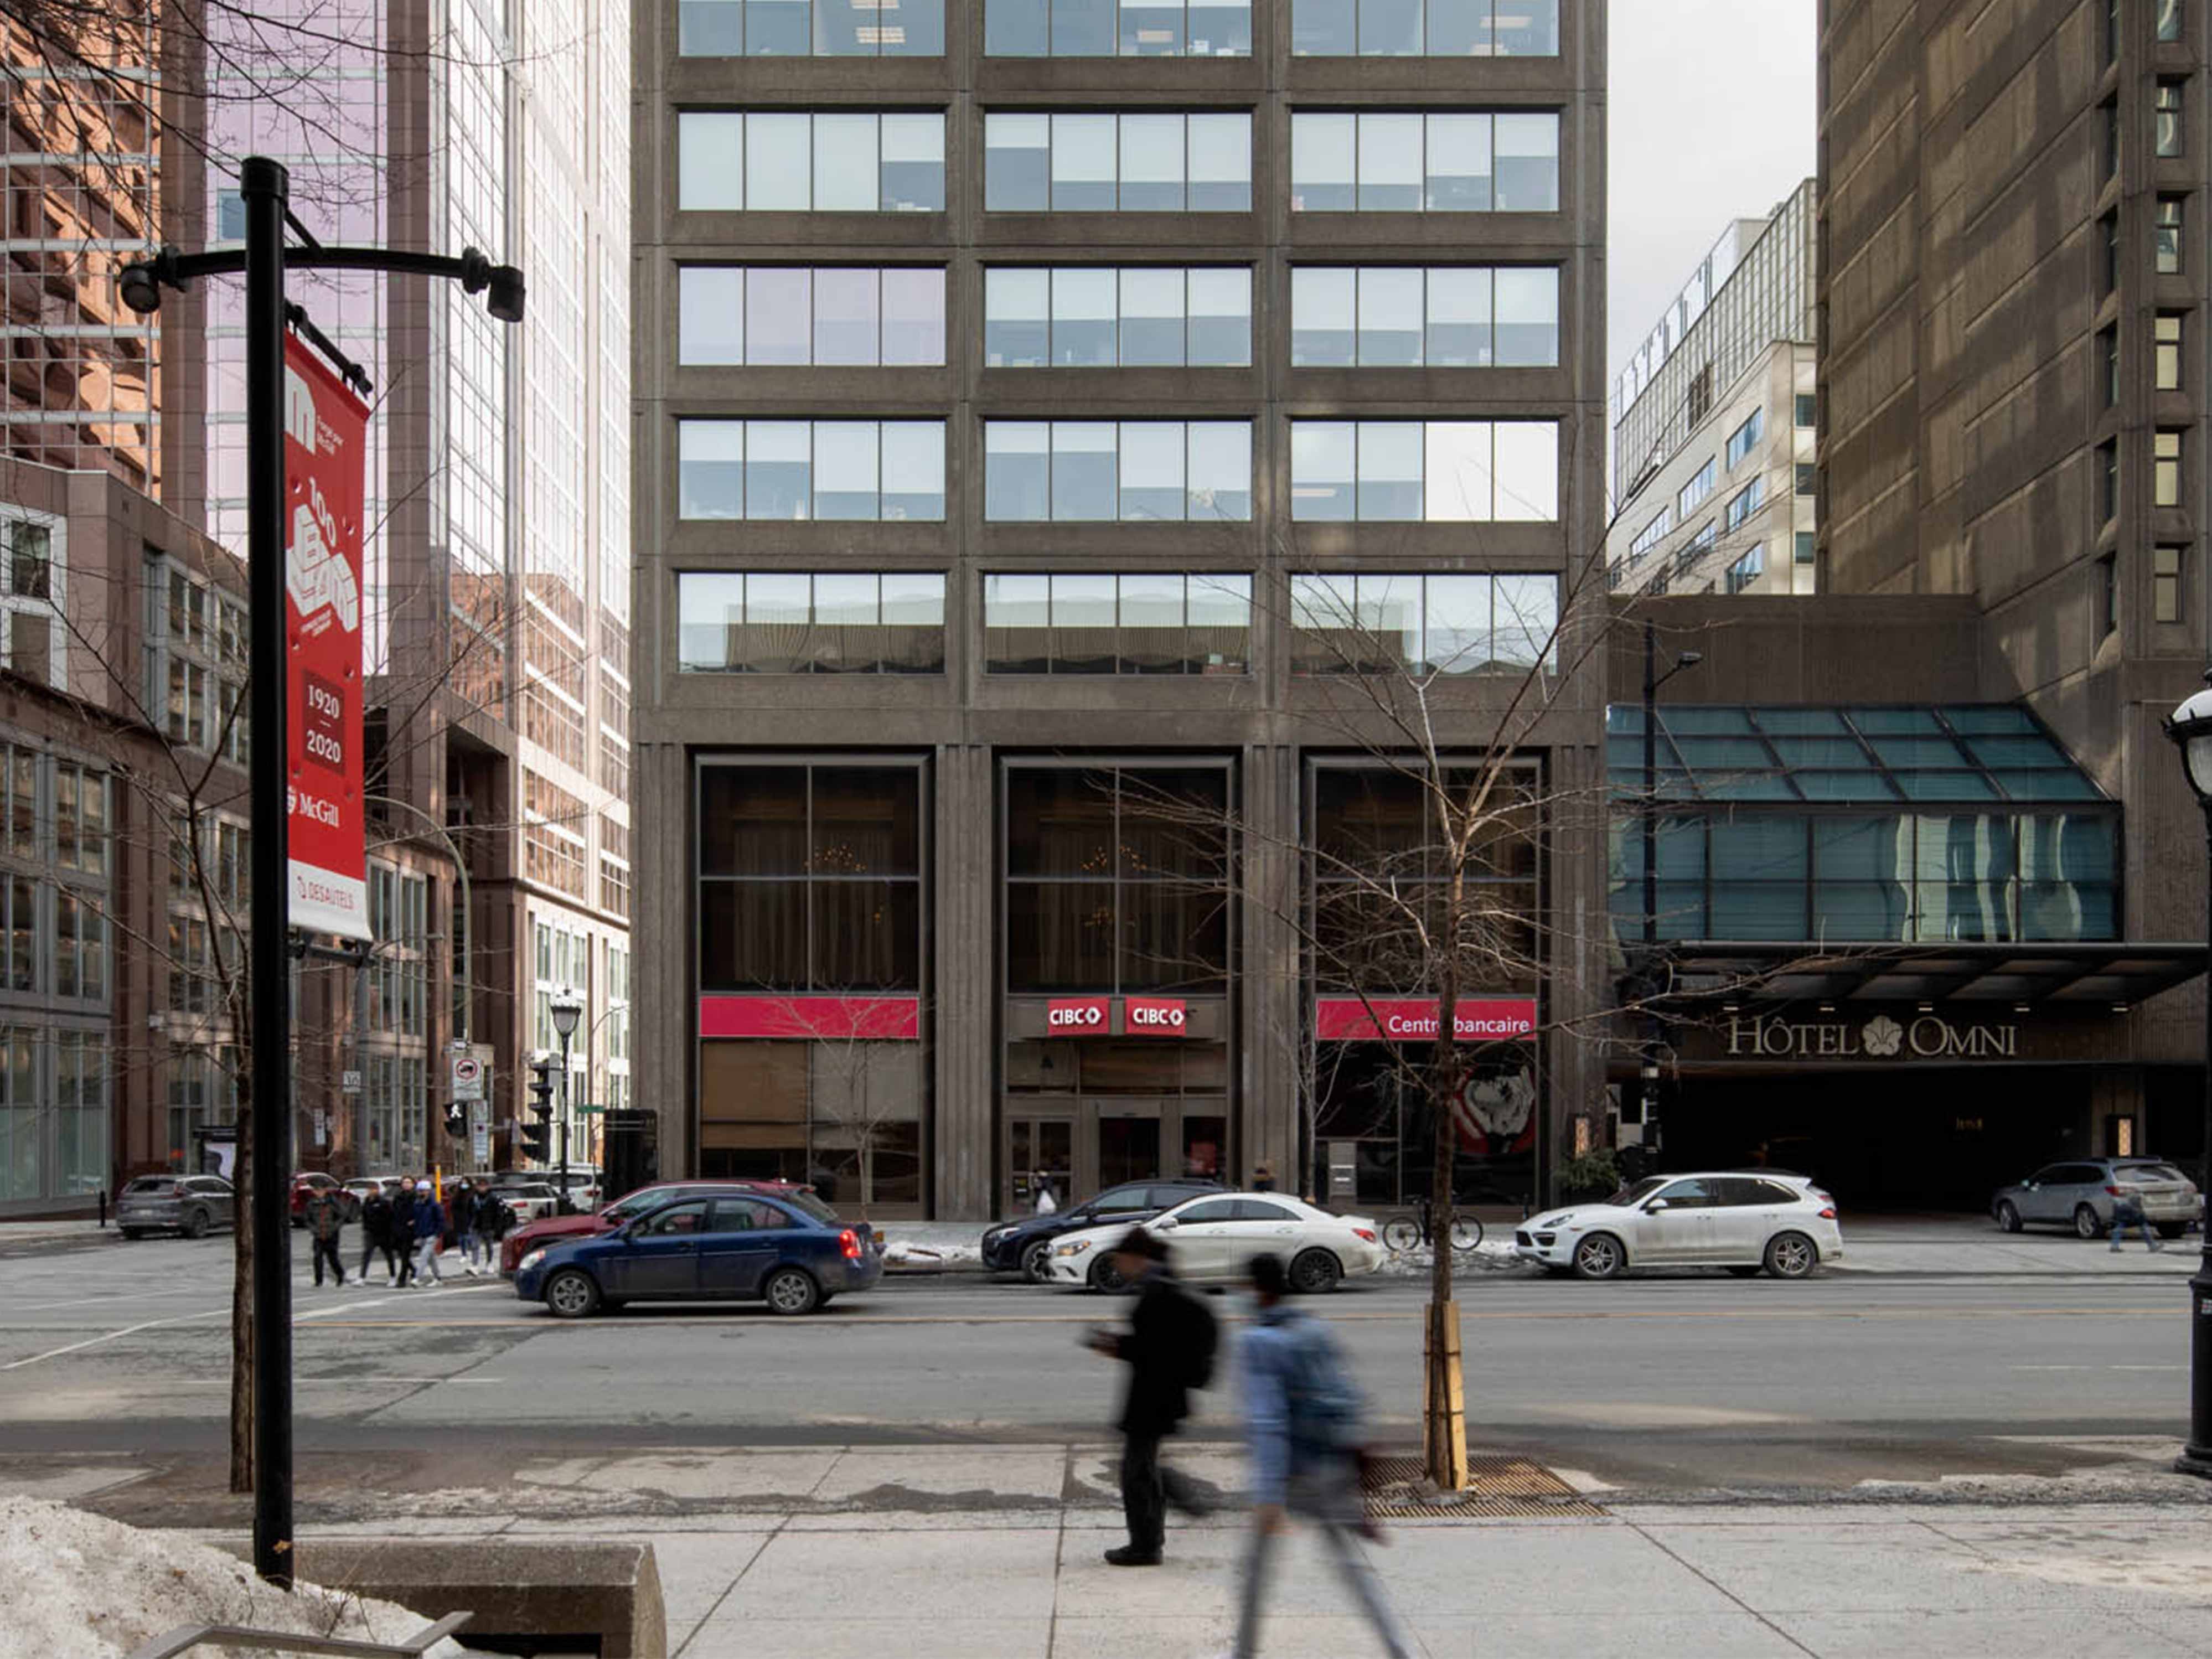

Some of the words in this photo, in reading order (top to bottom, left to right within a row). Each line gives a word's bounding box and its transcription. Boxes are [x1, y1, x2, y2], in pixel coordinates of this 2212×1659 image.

[308, 476, 336, 547] 100
[308, 685, 340, 719] 1920
[307, 729, 341, 763] 2020
[299, 793, 339, 828] McGill
[1050, 1008, 1085, 1025] CIBC
[1133, 1007, 1169, 1025] CIBC
[1388, 1015, 1440, 1033] Centr
[1453, 1014, 1530, 1033] bancaire
